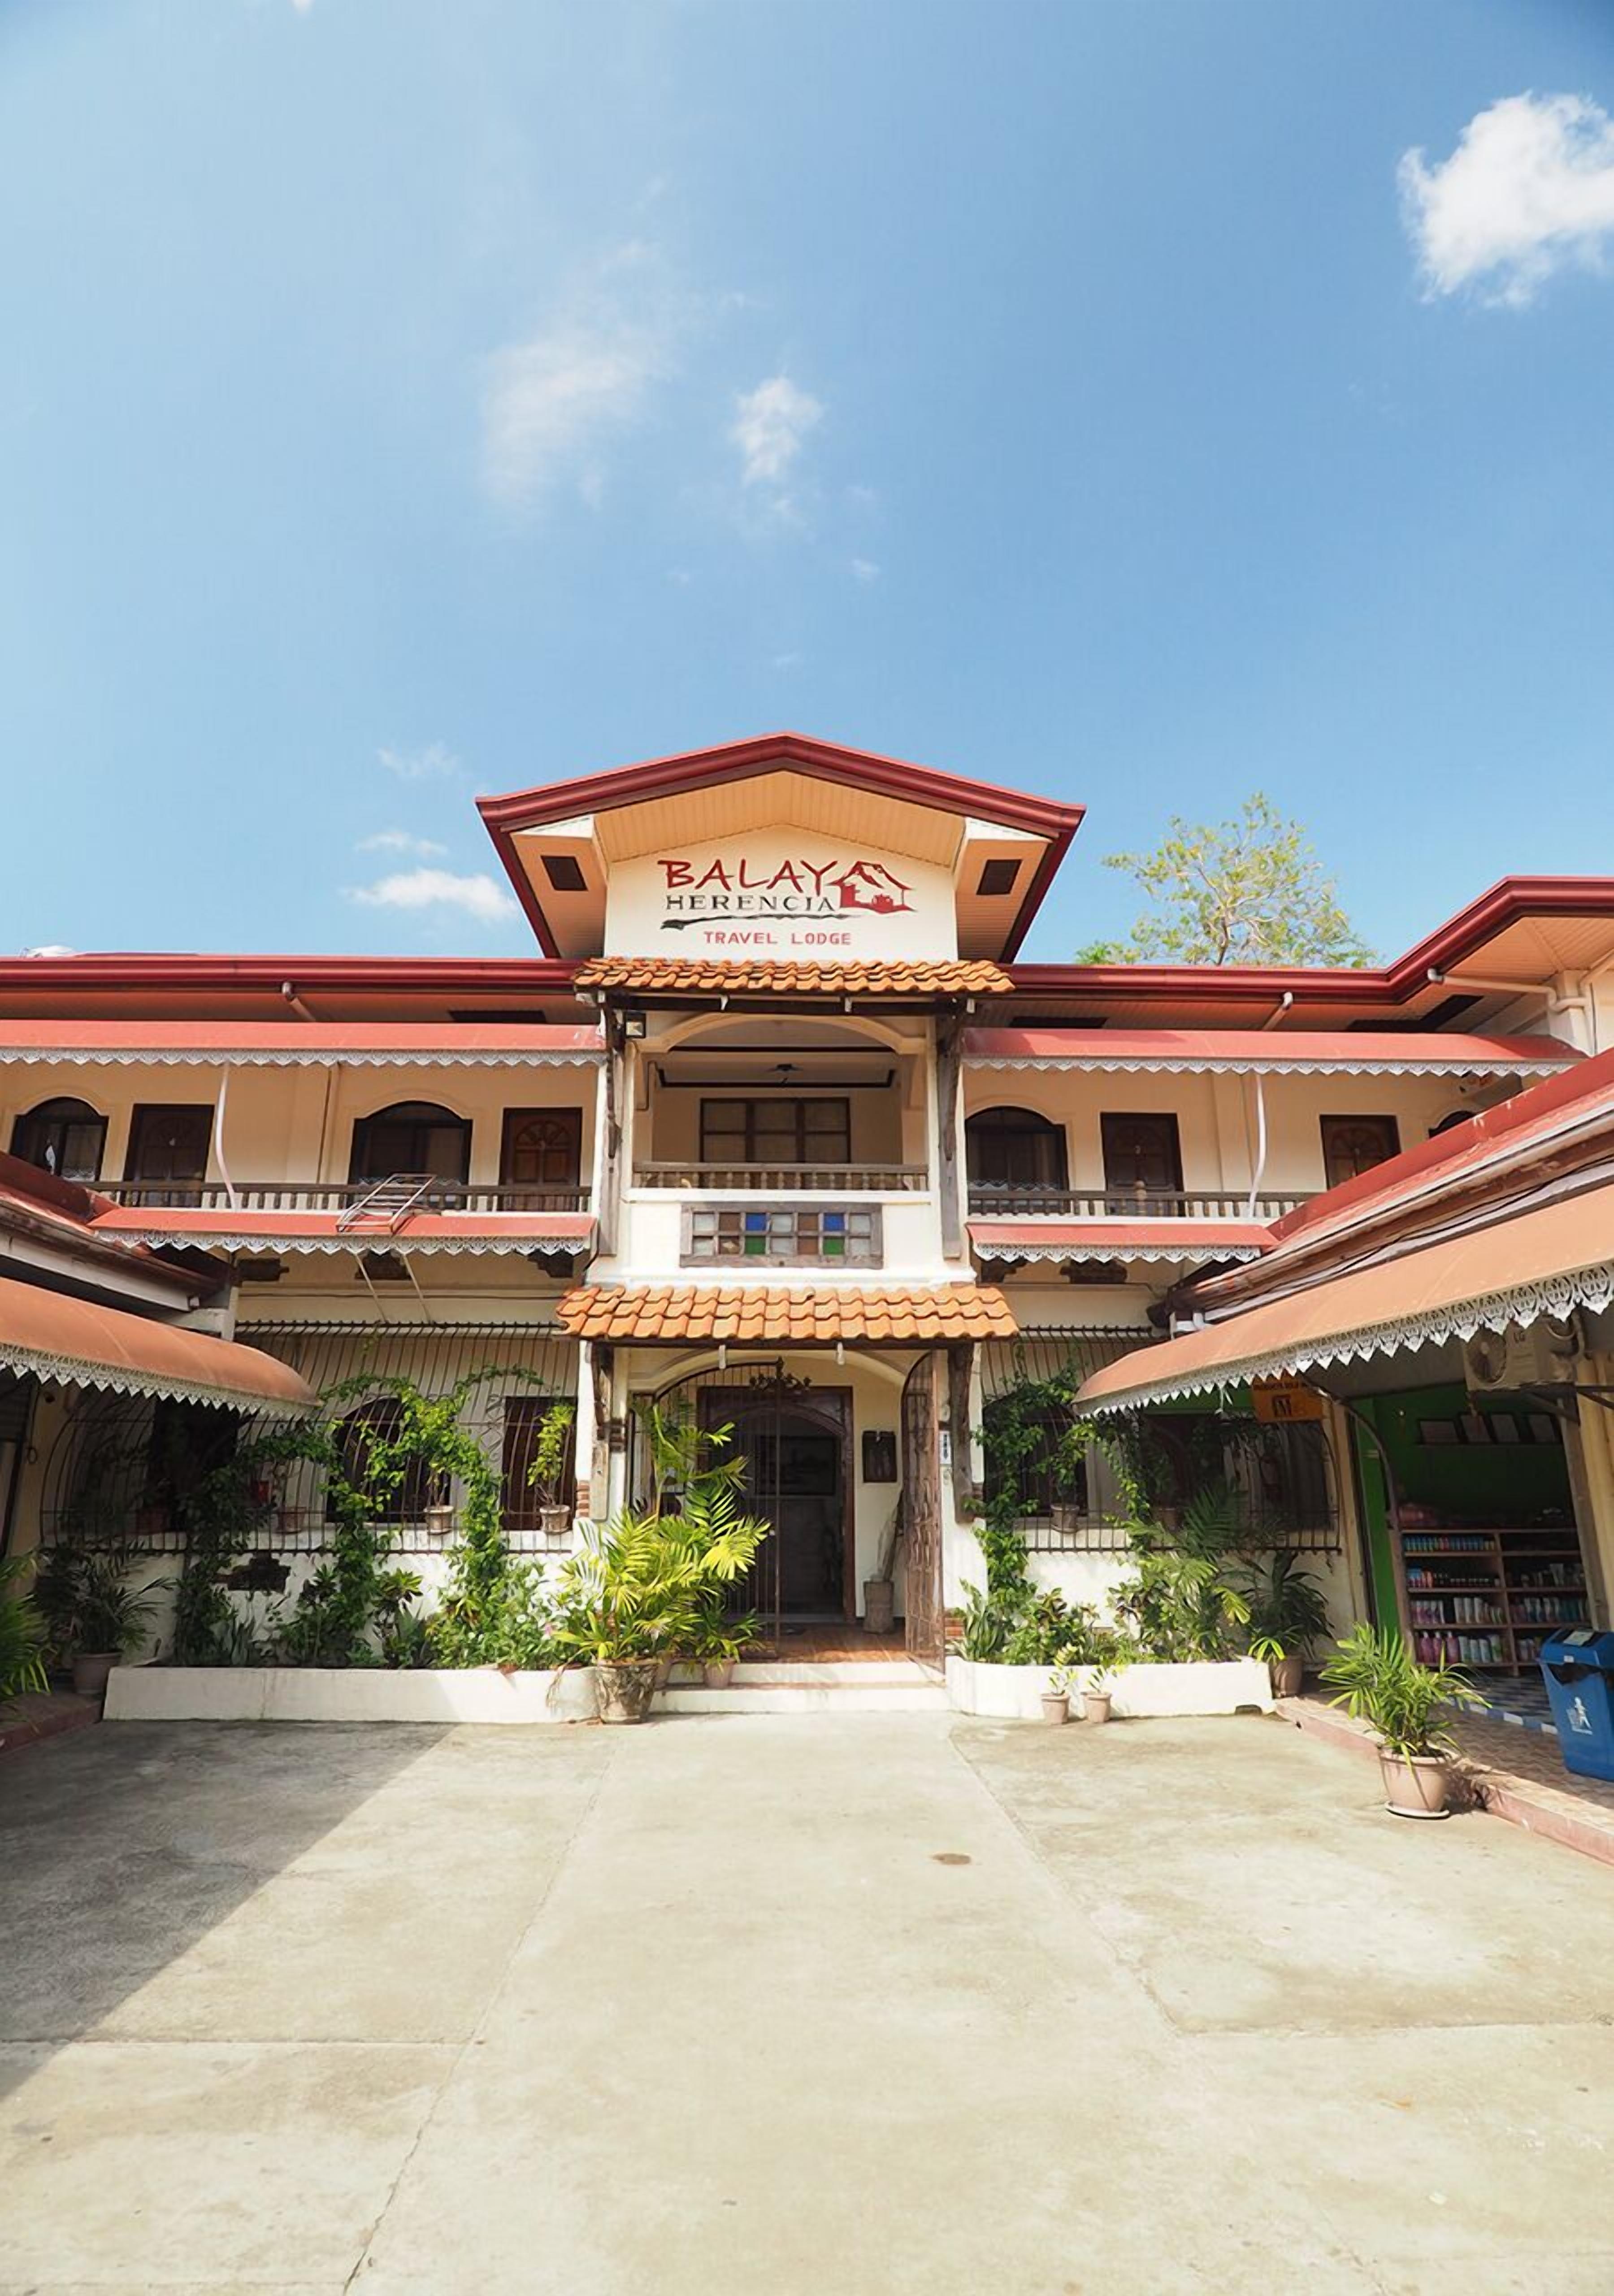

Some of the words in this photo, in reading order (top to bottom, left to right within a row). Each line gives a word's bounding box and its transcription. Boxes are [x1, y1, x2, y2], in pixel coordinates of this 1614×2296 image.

[657, 859, 838, 896] BALAY
[666, 895, 835, 912] HERENCIA
[704, 931, 778, 944] TRAVEL
[790, 932, 851, 945] LODGE
